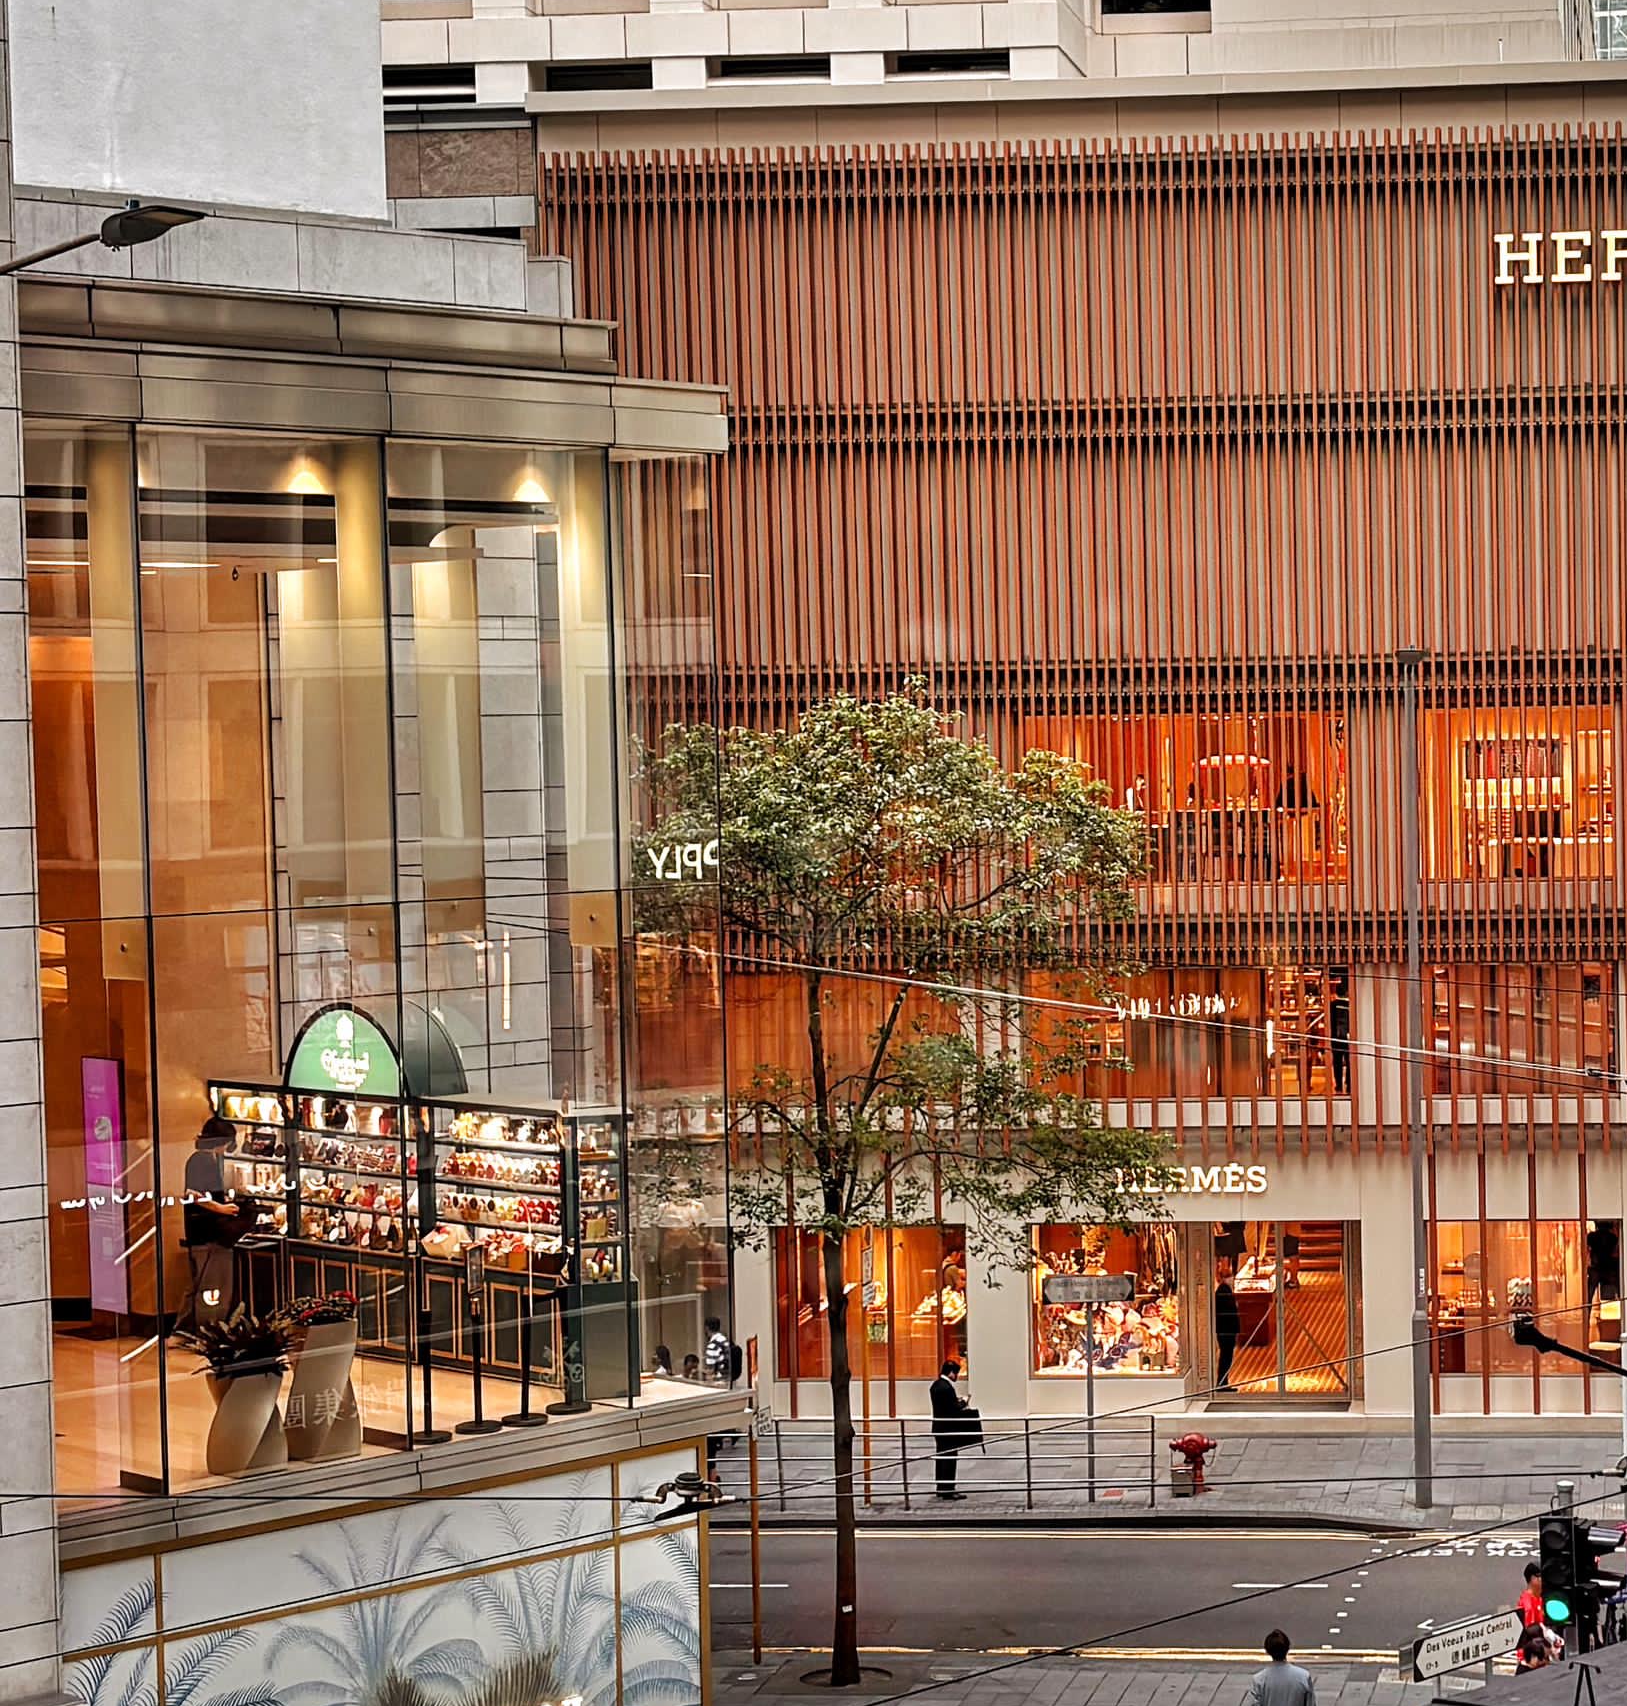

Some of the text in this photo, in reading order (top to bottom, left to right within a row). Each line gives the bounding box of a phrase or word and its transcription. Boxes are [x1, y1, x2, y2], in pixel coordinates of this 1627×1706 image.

[1487, 1549, 1541, 1557] OOK
[1426, 1642, 1440, 1654] Des
[1466, 1629, 1484, 1642] Road
[1486, 1618, 1513, 1635] Central
